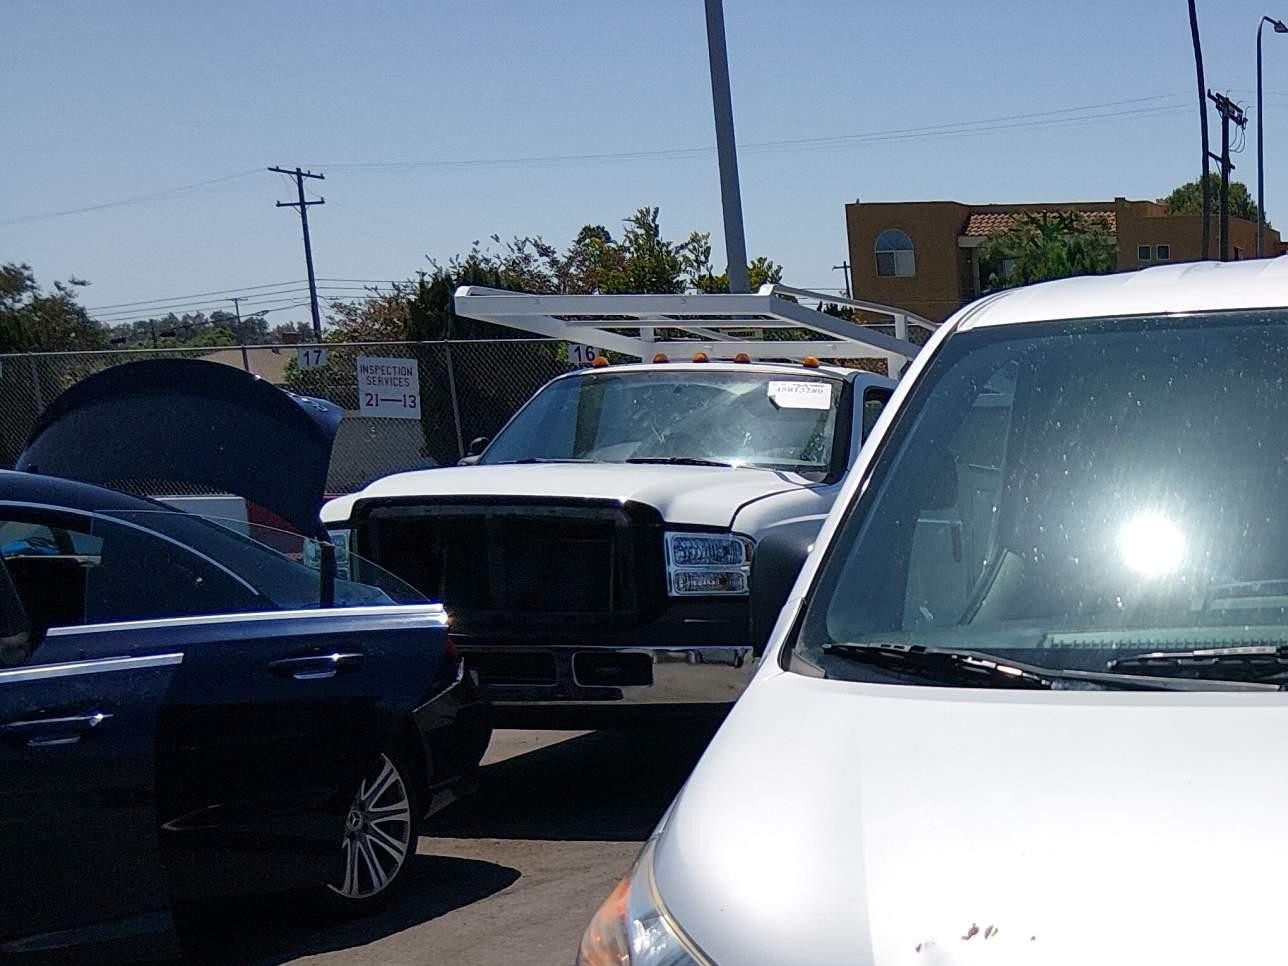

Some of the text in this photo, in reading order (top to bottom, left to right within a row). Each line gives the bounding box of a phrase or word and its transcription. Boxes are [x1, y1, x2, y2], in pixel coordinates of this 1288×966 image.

[303, 349, 322, 366] 17
[574, 345, 596, 362] 16
[360, 364, 413, 377] INSPECTION
[366, 377, 411, 387] SERVICES
